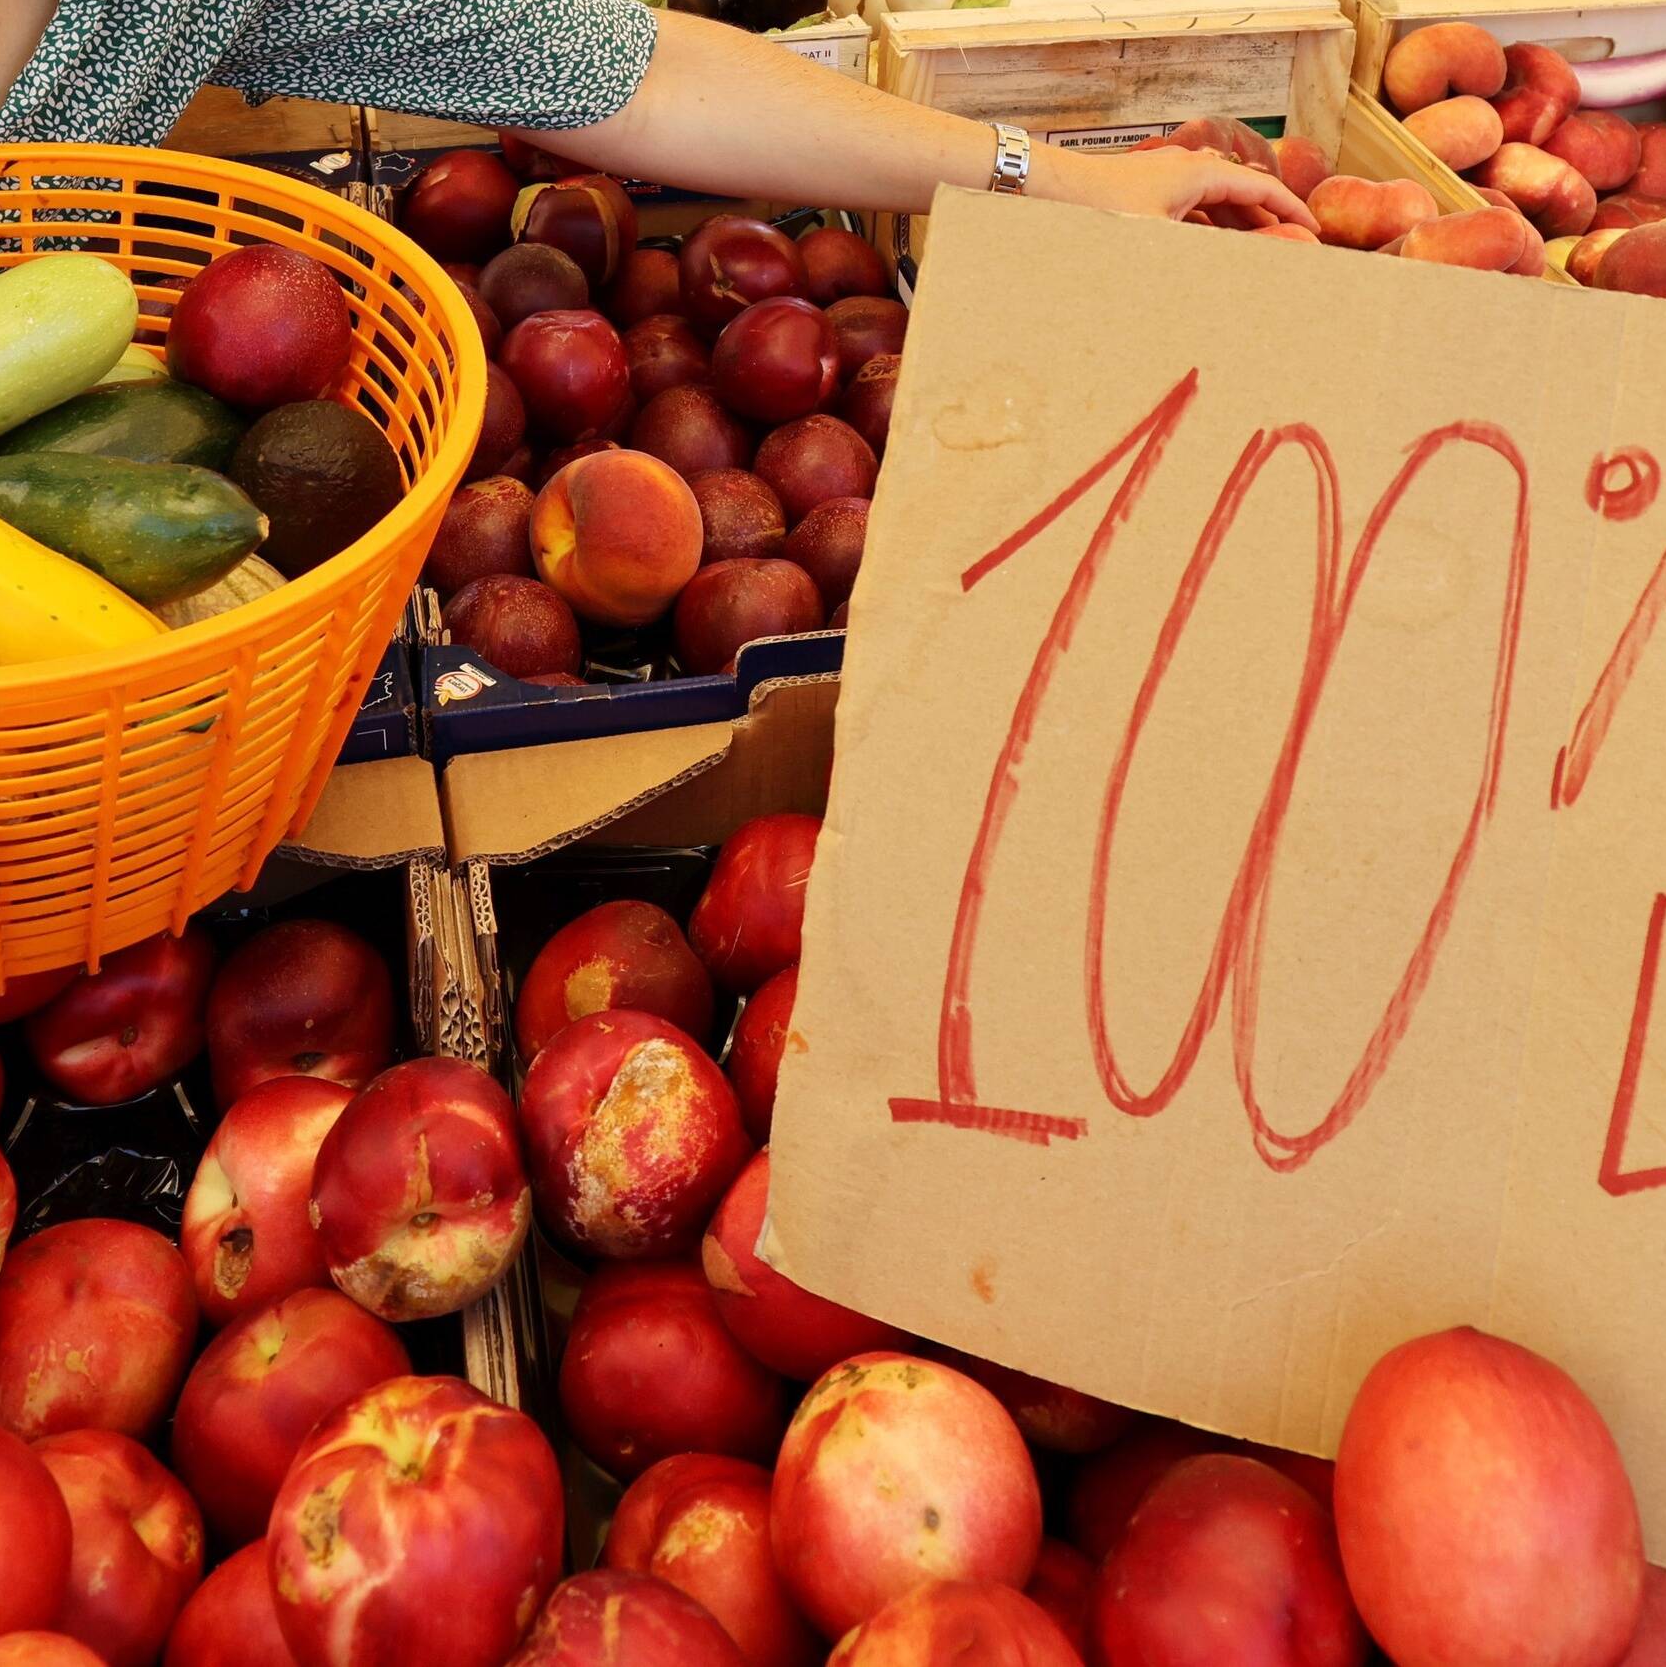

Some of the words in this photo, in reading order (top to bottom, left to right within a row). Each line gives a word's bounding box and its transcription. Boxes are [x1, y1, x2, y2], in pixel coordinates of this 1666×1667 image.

[824, 50, 831, 58] II
[1059, 138, 1080, 147] SARL
[1081, 136, 1112, 146] POUMO
